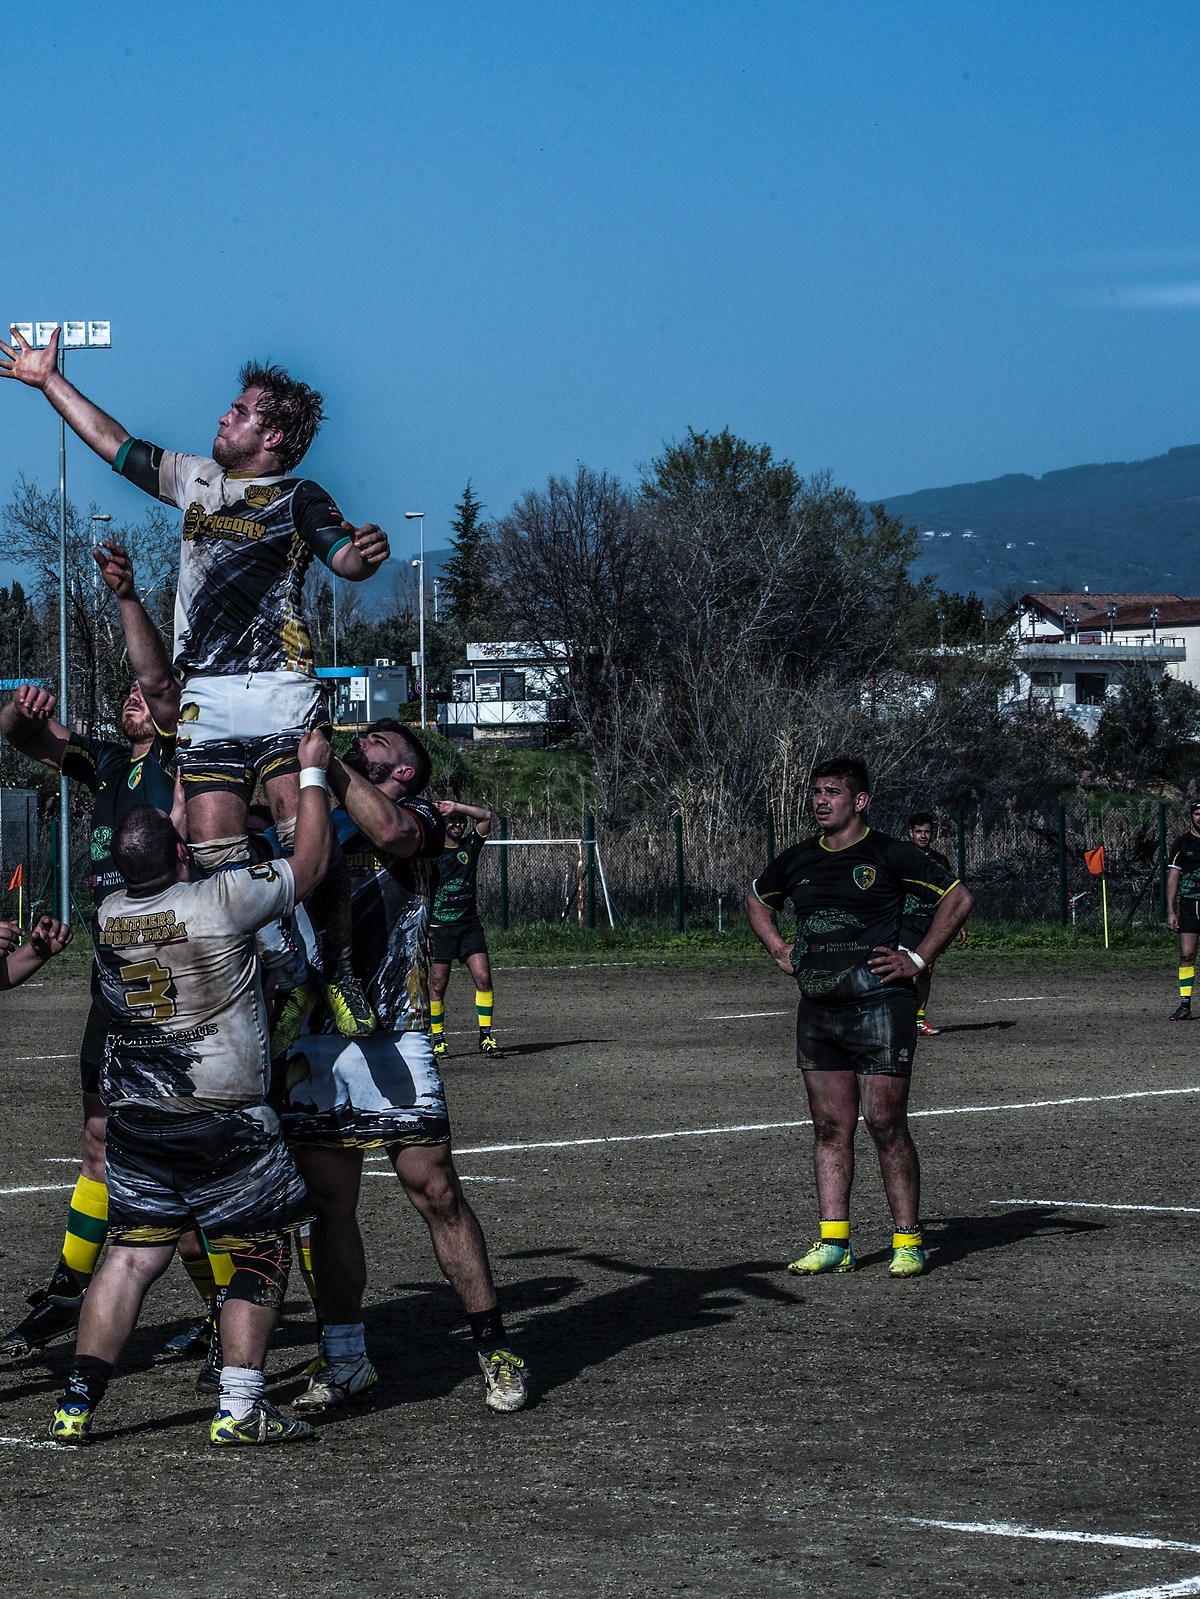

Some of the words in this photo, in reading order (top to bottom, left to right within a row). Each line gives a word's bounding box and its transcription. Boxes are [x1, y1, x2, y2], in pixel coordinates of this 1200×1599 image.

[105, 909, 176, 932] PANTHERS
[99, 930, 140, 946] RUGBY
[142, 922, 188, 943] TEAM
[118, 957, 177, 1024] 3
